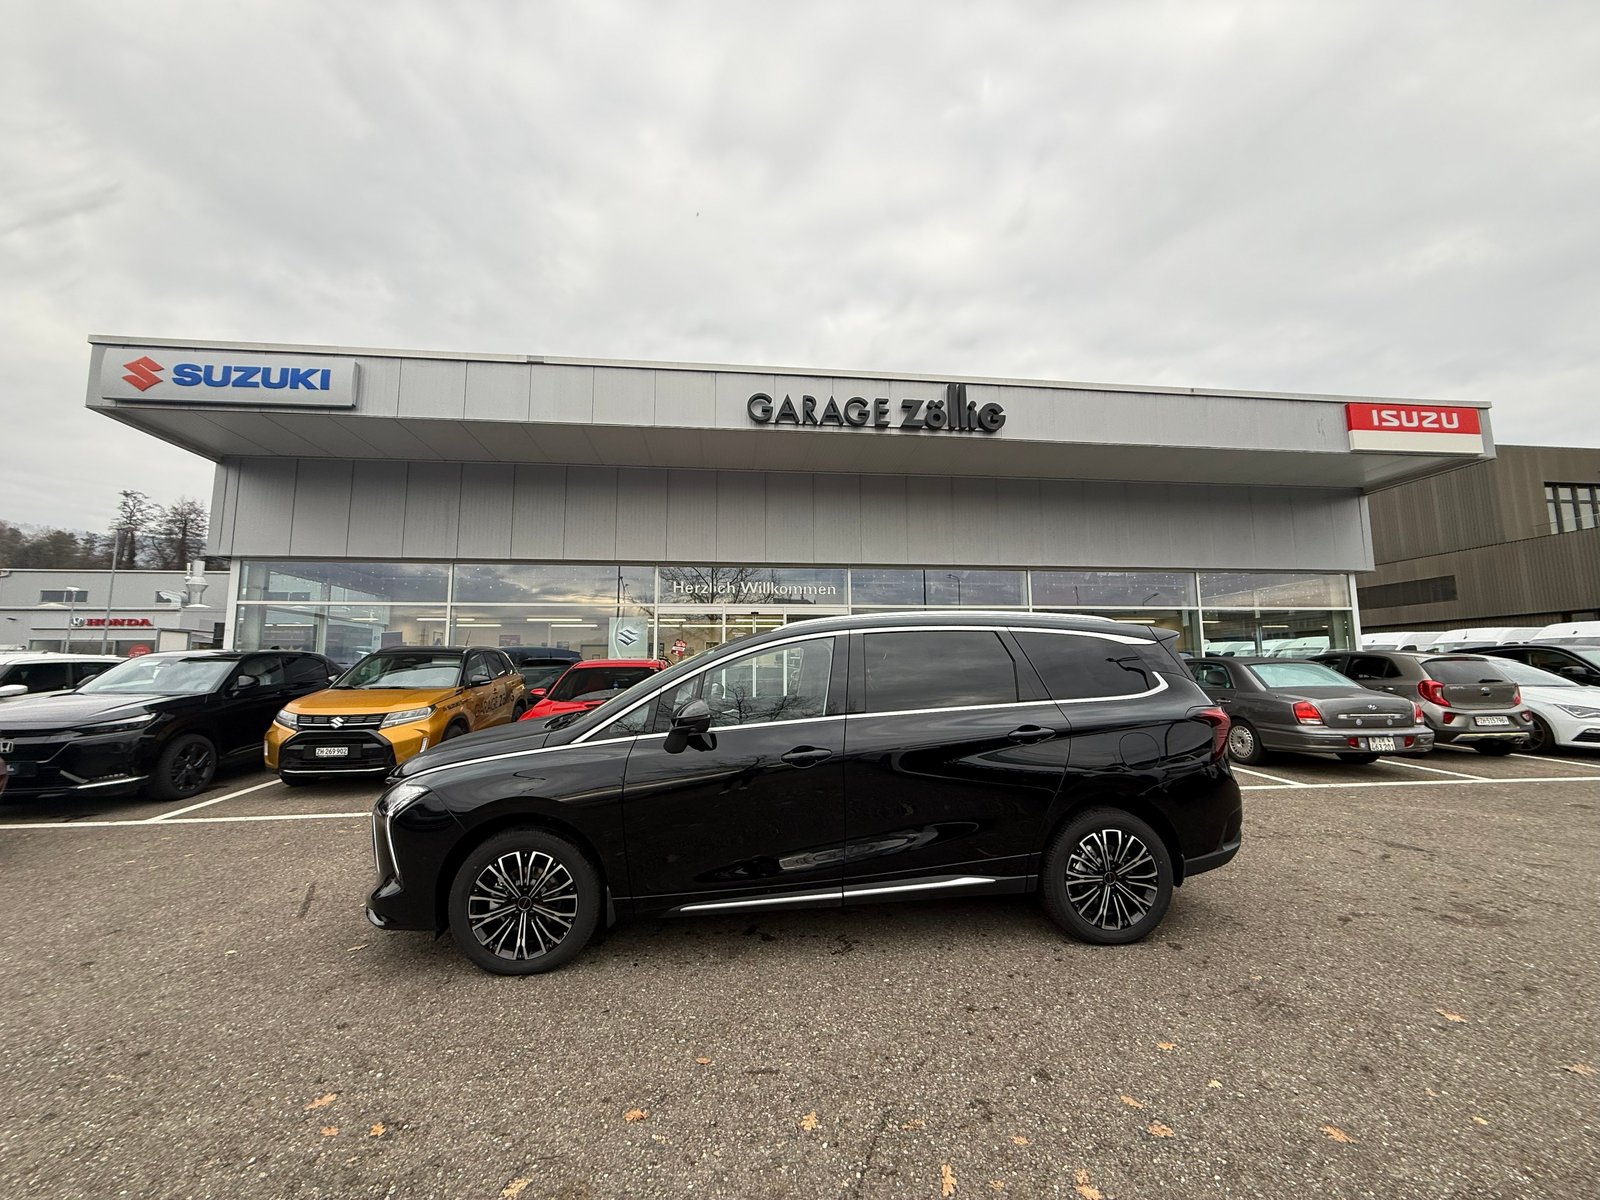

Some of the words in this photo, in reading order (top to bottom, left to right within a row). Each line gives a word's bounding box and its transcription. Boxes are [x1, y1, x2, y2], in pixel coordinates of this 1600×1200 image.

[172, 363, 331, 391] SUZUKI
[747, 392, 890, 428] GARAGE
[1371, 409, 1459, 429] ISUZU
[673, 581, 736, 594] Herzlich
[740, 581, 836, 595] Willkommen
[86, 618, 154, 626] HONDA
